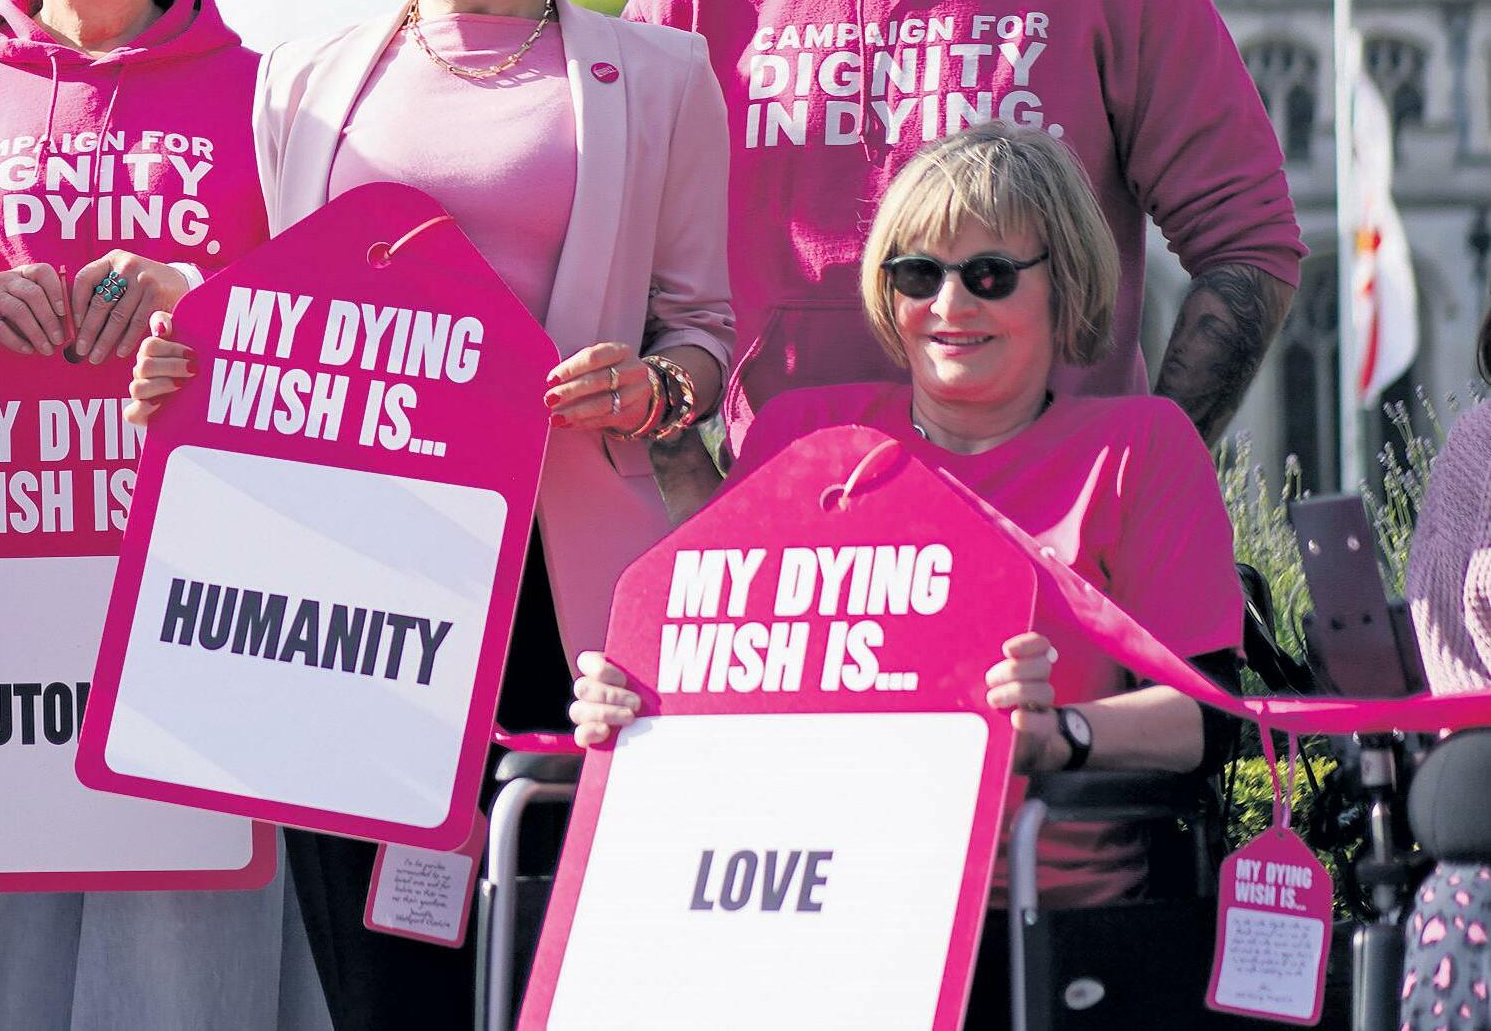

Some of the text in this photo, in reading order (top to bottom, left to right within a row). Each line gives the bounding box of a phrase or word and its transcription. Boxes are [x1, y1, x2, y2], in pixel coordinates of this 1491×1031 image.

[753, 12, 1049, 50] CAMPAIGN FOR
[749, 41, 1047, 100] DIGNITY
[142, 130, 214, 161] FOR
[745, 90, 1064, 148] IN DYING.
[3, 194, 221, 255] DYING.
[219, 285, 484, 384] MY DYING
[207, 358, 447, 457] WISH IS...
[666, 543, 953, 618] MY DYING
[159, 578, 453, 686] HUMANITY
[657, 620, 919, 693] WISH IS...
[689, 849, 833, 914] LOVE
[1235, 858, 1312, 889] MY DYING
[1235, 881, 1307, 911] WISH IS...
